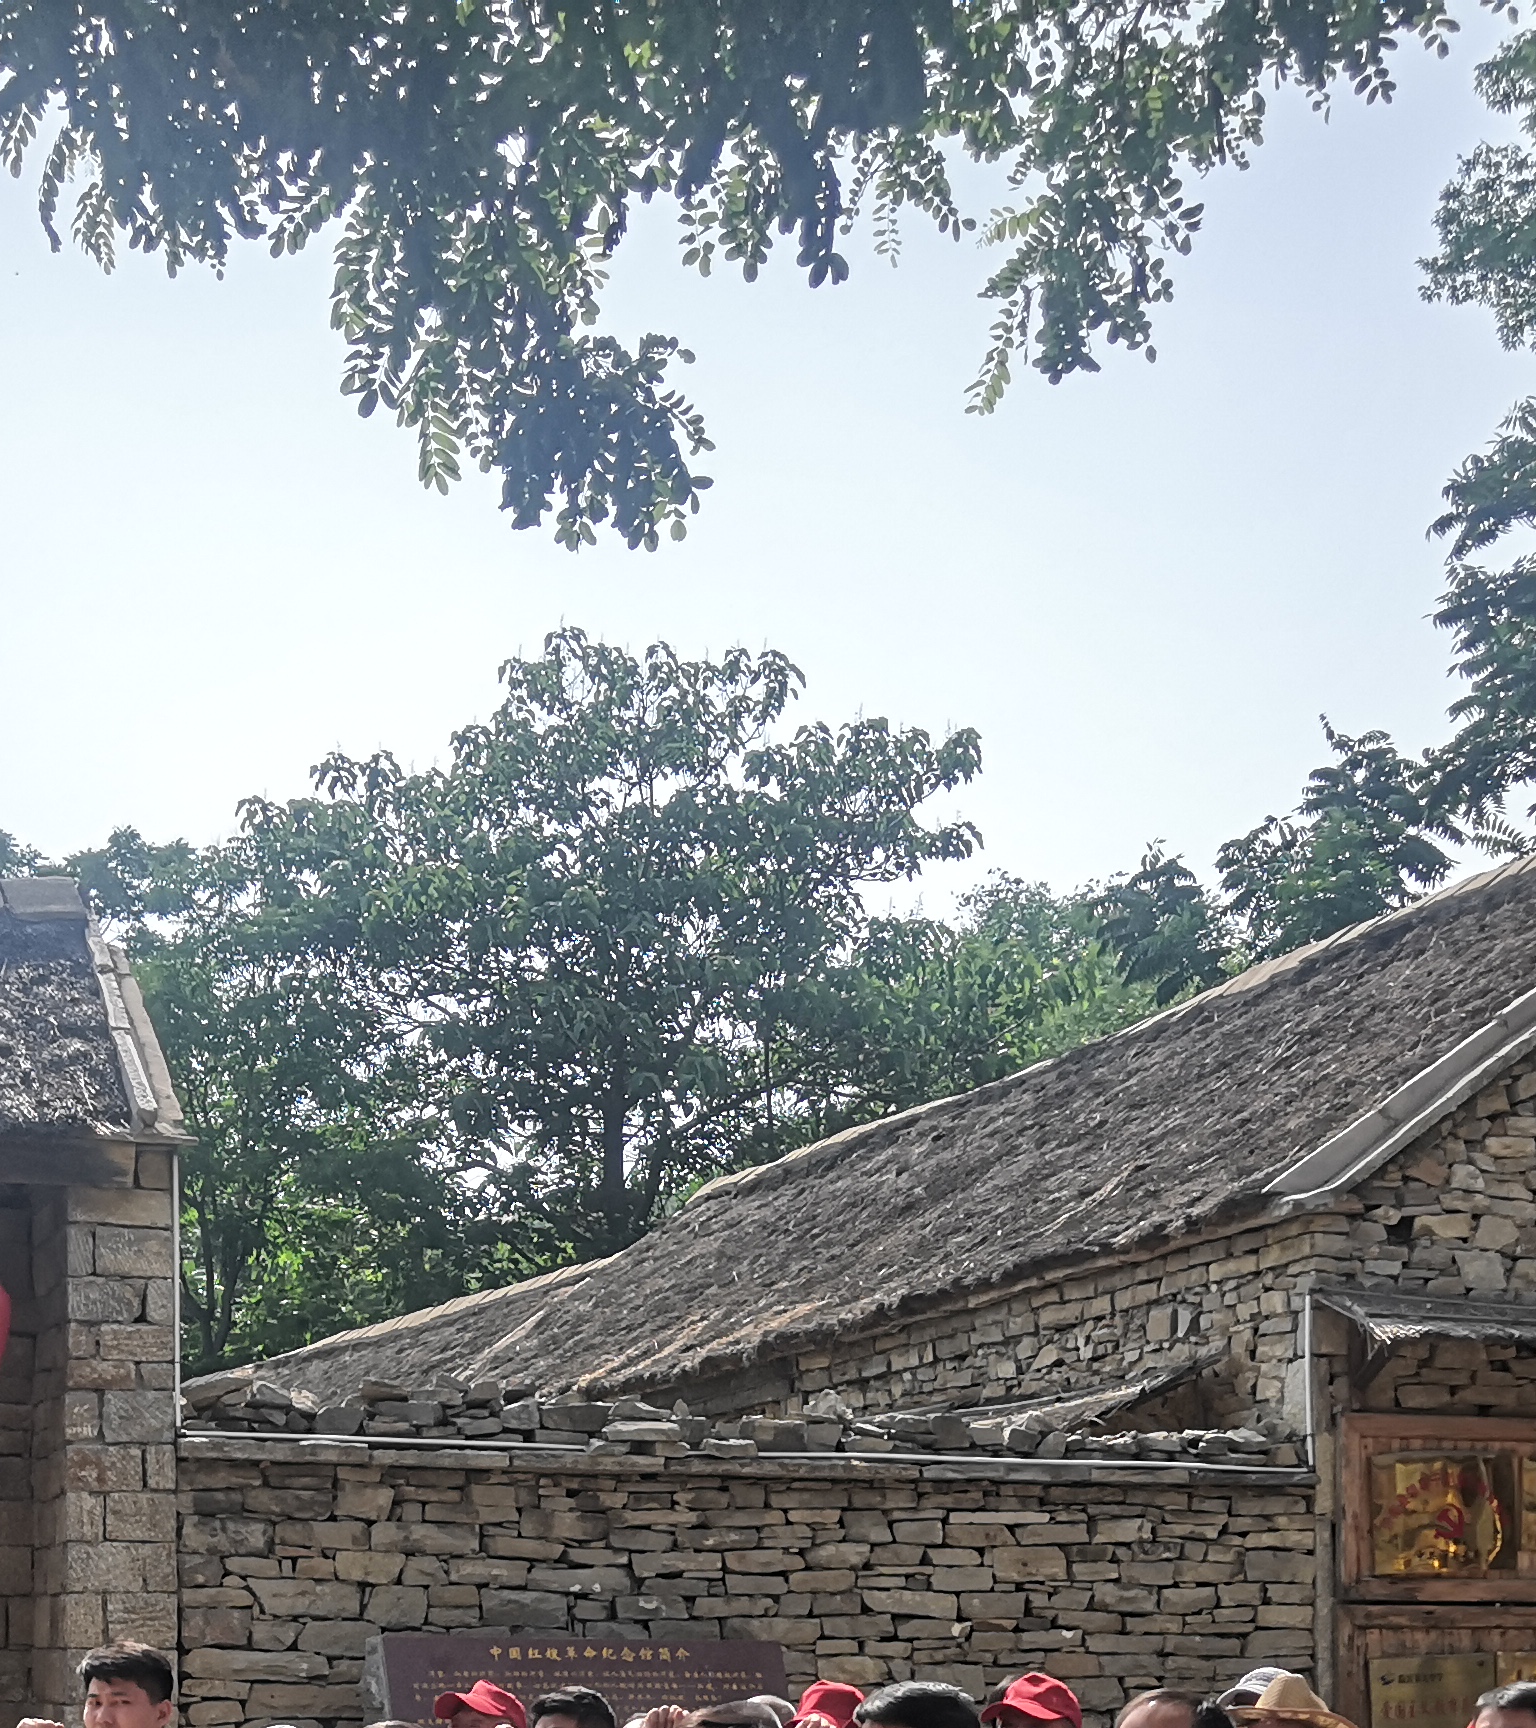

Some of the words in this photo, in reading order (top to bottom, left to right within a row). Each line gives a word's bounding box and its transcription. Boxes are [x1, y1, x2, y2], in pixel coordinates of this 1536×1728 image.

[488, 1645, 691, 1662] 中国红嫂革命纪念馆简介
